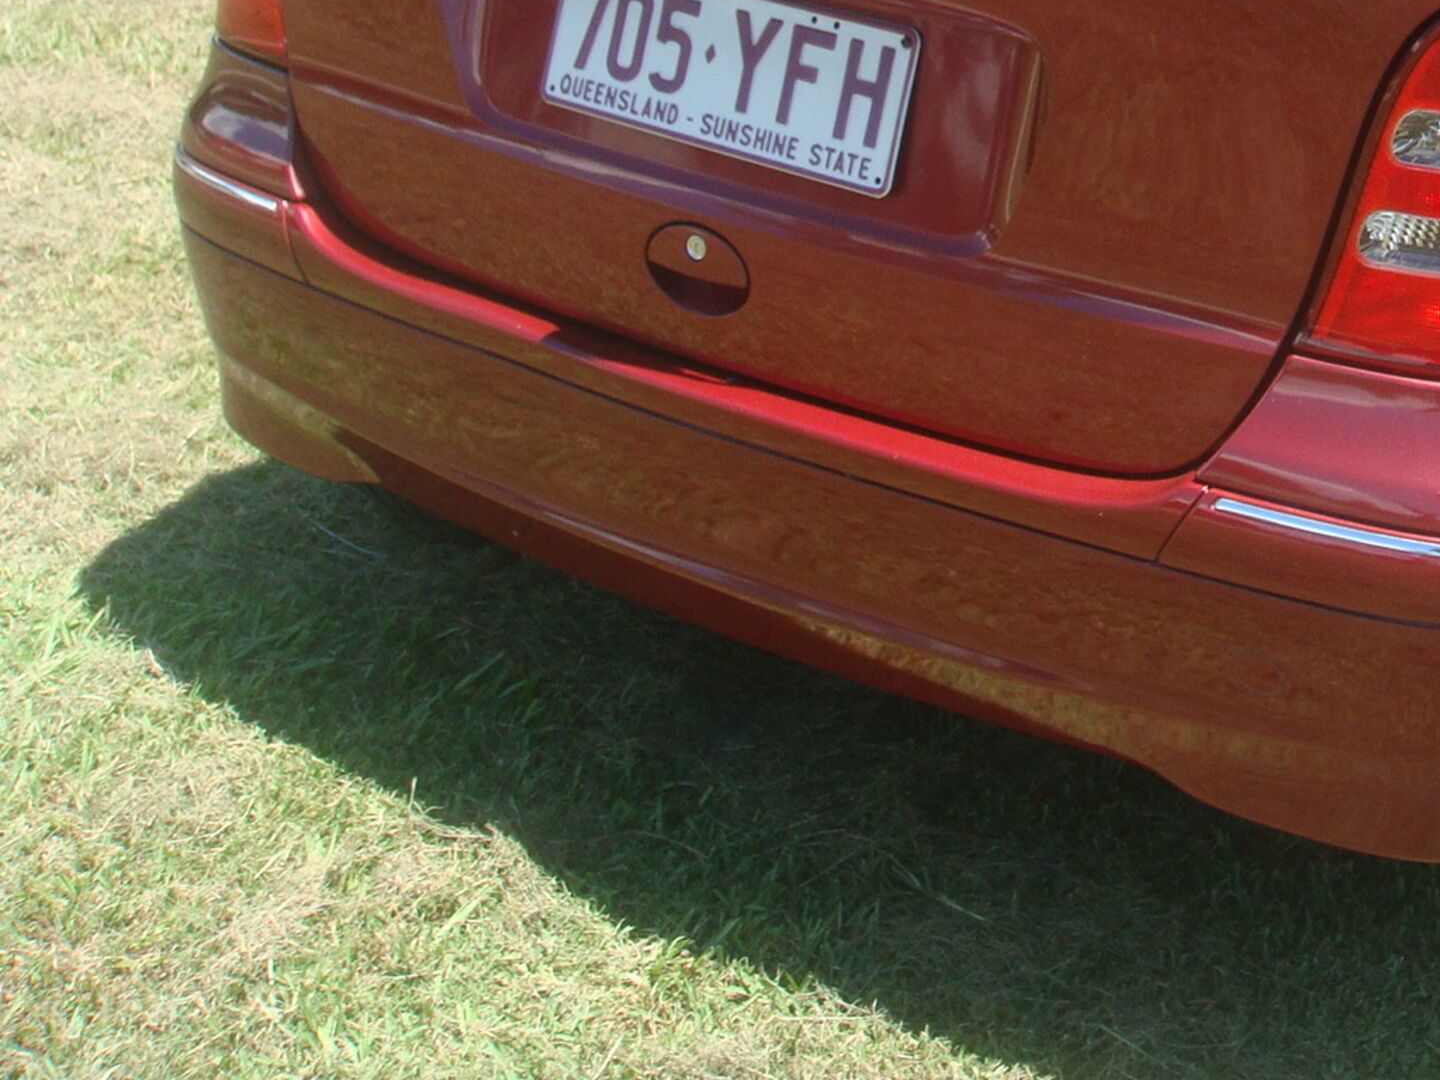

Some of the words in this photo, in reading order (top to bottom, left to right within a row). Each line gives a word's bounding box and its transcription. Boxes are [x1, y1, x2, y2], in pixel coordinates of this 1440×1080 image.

[560, 74, 679, 125] QUEENSLAND
[700, 113, 799, 161] SUNSHINE
[809, 143, 872, 181] STATE
